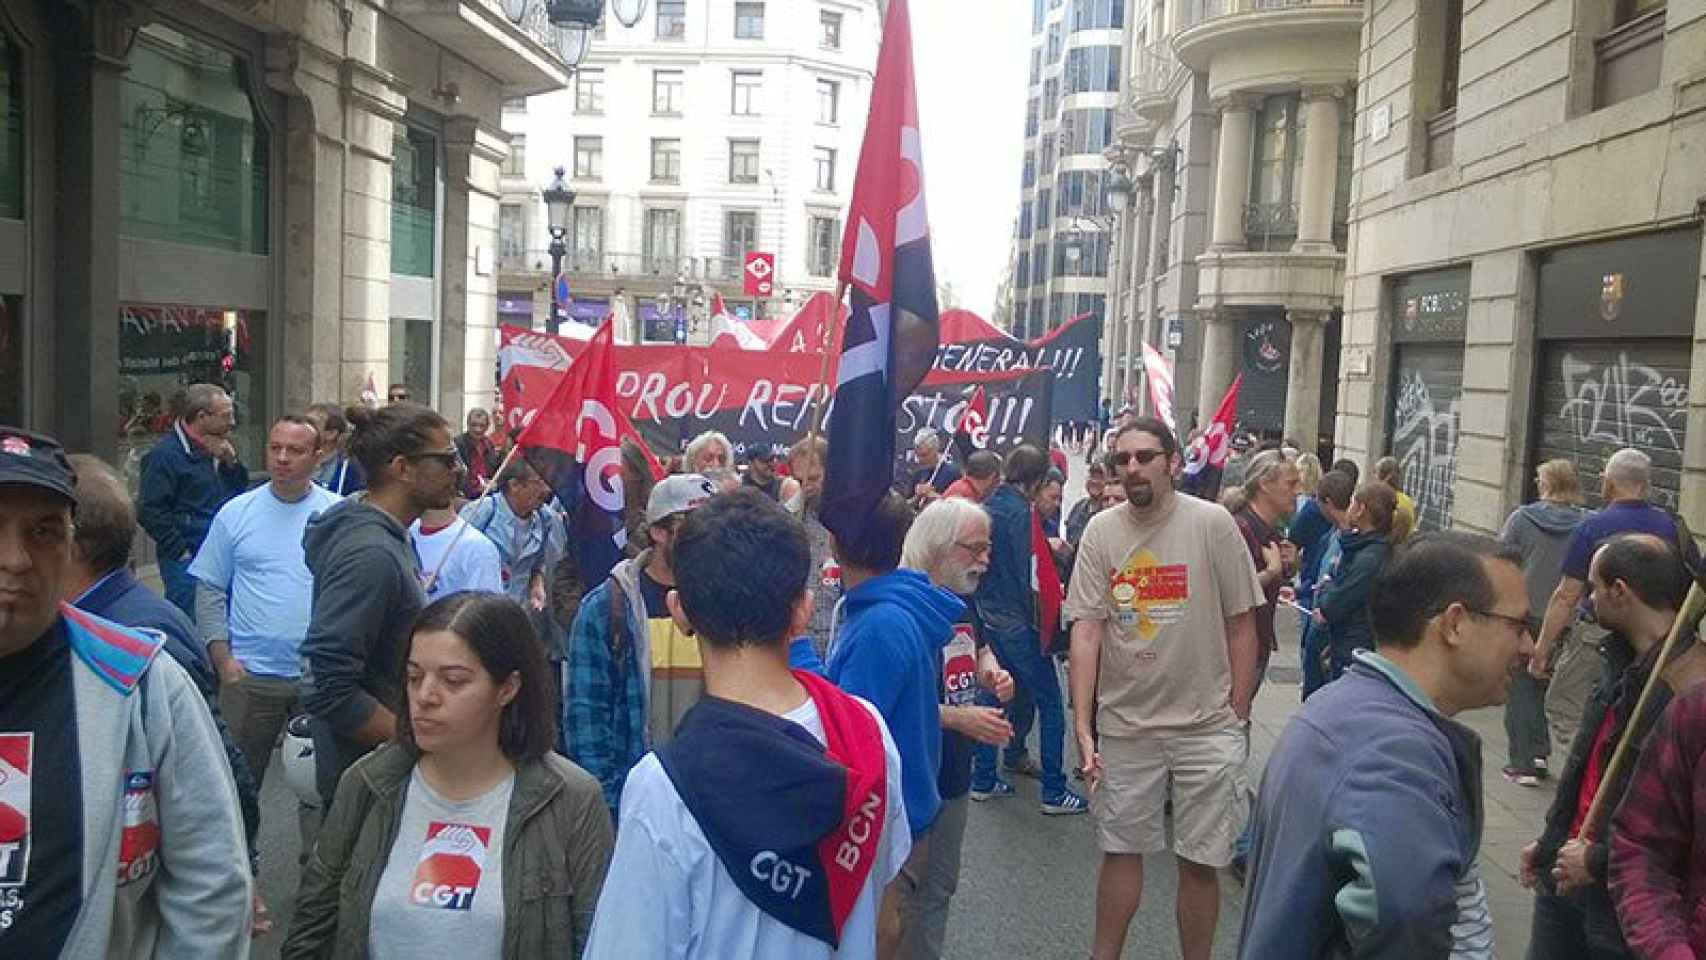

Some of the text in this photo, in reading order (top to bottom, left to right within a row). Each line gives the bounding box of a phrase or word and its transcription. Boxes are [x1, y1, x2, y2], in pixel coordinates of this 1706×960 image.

[616, 370, 728, 426] PROU
[835, 791, 882, 873] BCN
[414, 882, 473, 908] CGT
[750, 850, 812, 900] CGT
